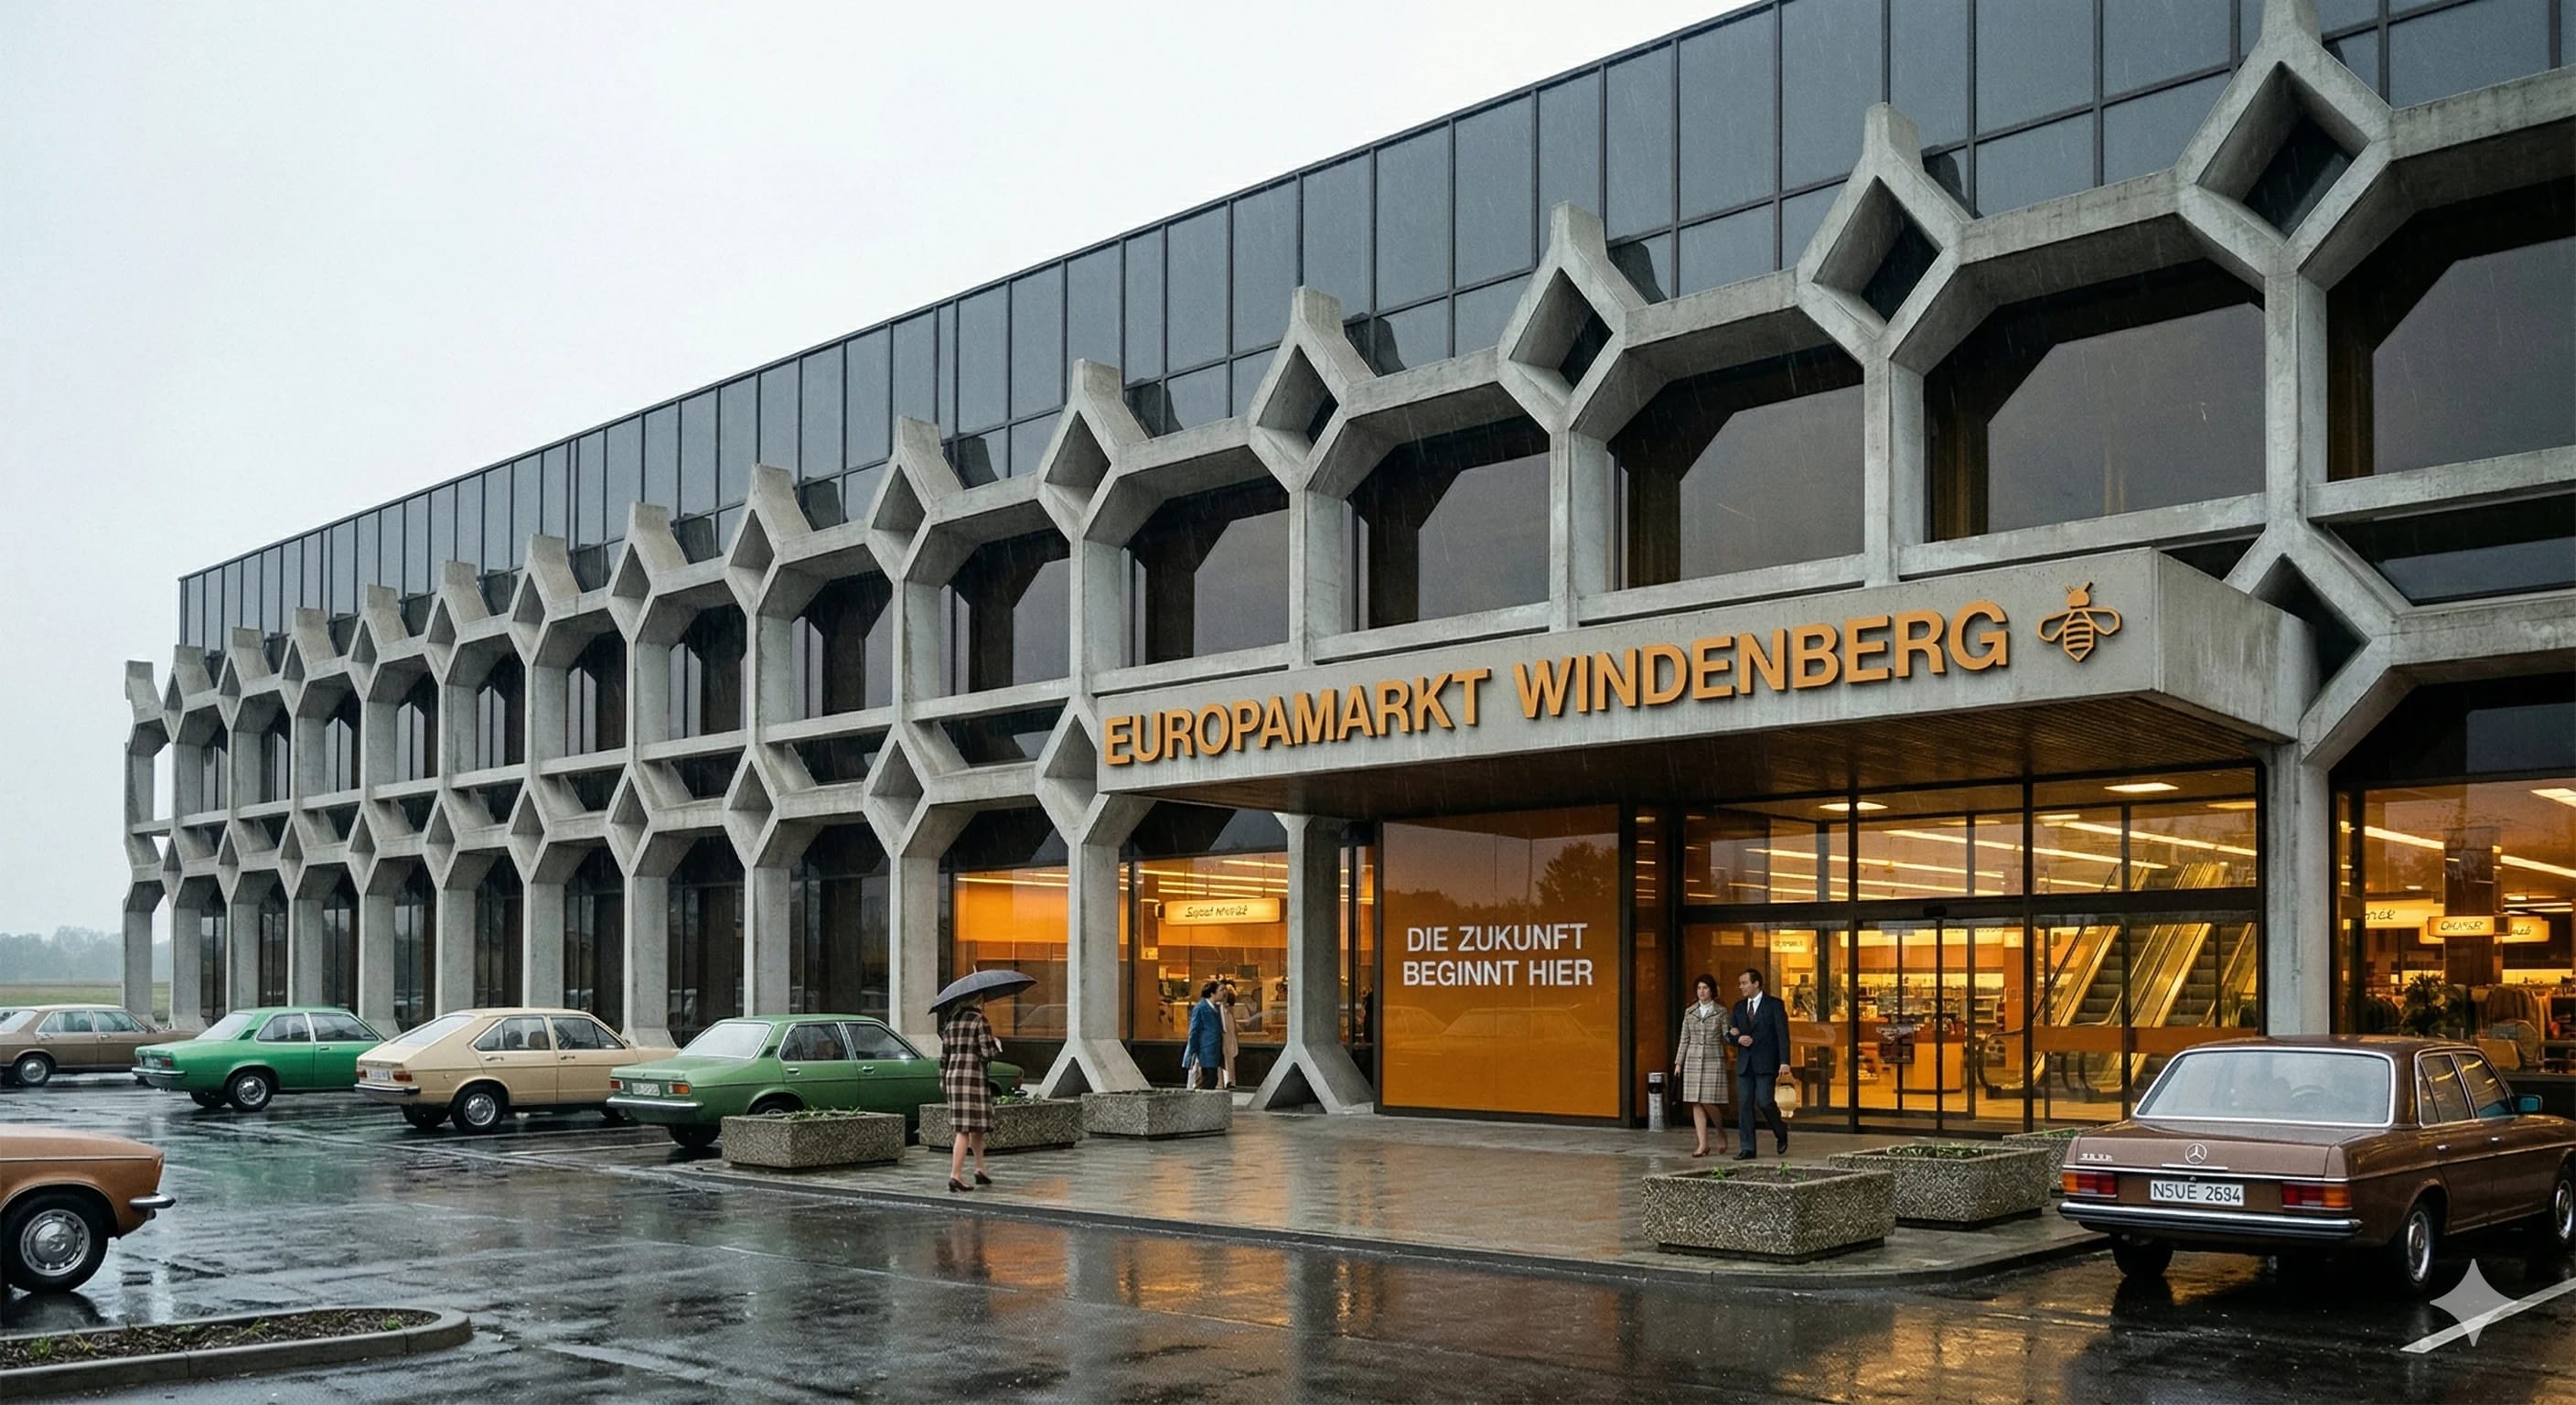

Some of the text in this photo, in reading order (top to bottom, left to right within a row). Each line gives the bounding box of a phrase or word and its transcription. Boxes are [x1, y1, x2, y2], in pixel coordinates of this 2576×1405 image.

[1104, 599, 2010, 766] EUROPAMARKT WINDENBERG
[1407, 923, 1588, 952] DIE ZUKUNFT
[1402, 959, 1594, 986] BEGINNT HIER
